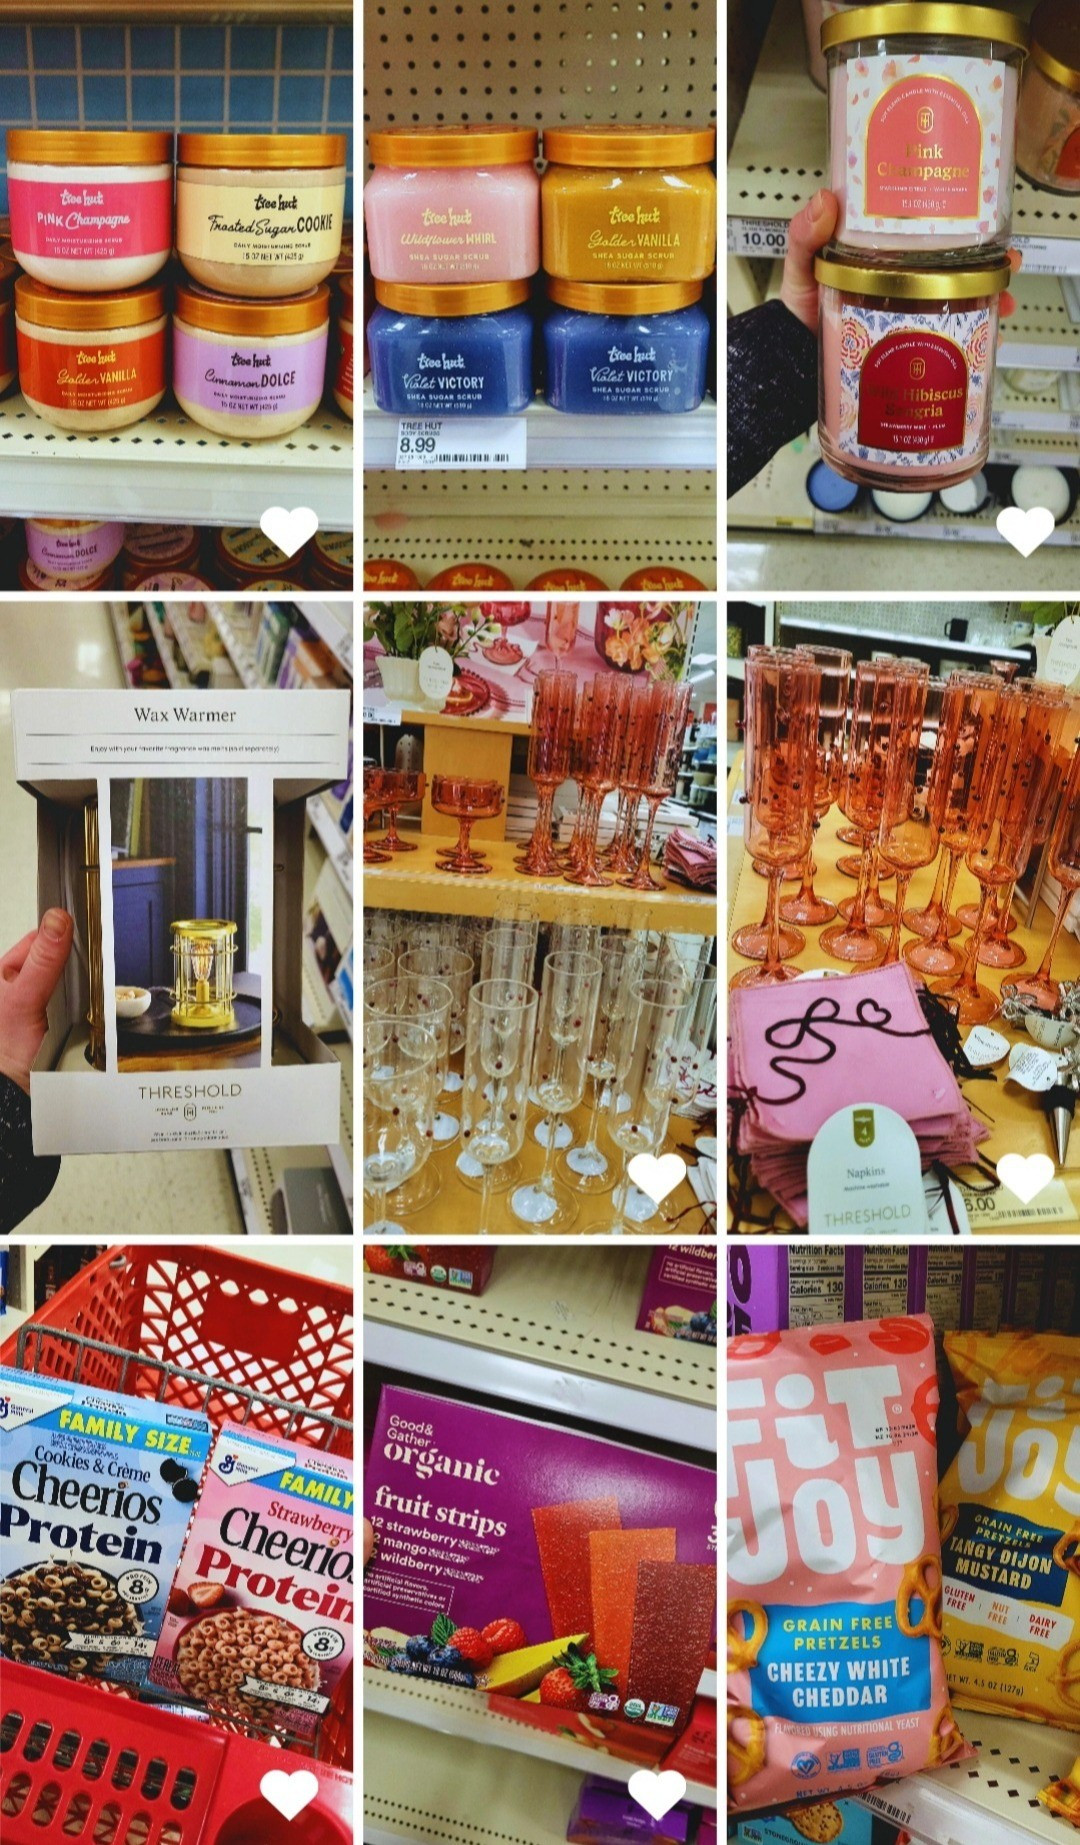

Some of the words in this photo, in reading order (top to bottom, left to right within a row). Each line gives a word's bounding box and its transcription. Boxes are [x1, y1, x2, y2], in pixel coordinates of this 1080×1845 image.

[906, 144, 944, 159] Pink
[877, 162, 970, 181] Champagne
[60, 188, 82, 206] tree
[83, 189, 104, 206] hut
[254, 193, 277, 210] tree
[278, 193, 298, 210] hut
[37, 212, 64, 227] PINK
[66, 212, 130, 230] Champagne
[422, 208, 448, 226] tree
[448, 207, 472, 226] hut
[608, 205, 636, 224] tree
[635, 206, 660, 225] hut
[208, 214, 256, 233] Frosted
[254, 218, 297, 239] Sugar
[296, 213, 333, 233] COOKIE
[400, 232, 464, 247] Wildflower
[466, 232, 497, 245] WHIRL
[587, 229, 637, 249] Golden
[636, 232, 680, 247] VANILLA
[743, 232, 786, 246] 10.00
[408, 254, 430, 262] SHEA
[432, 254, 460, 262] SUGAR
[463, 254, 490, 262] SCRUB
[592, 252, 614, 260] SHEA
[616, 252, 644, 260] SUGAR
[648, 252, 675, 260] SCRUB
[76, 350, 97, 366] tree
[97, 350, 117, 365] hut
[230, 352, 252, 368] tree
[252, 352, 272, 368] hut
[417, 352, 442, 369] tree
[442, 352, 466, 370] hut
[608, 346, 632, 363] tree
[633, 346, 656, 363] hut
[56, 368, 100, 386] Golden
[100, 367, 137, 384] VANILLA
[204, 368, 260, 388] Cinnamon
[260, 370, 296, 388] DOLCE
[402, 374, 436, 390] Violet
[438, 376, 484, 389] VICTORY
[589, 366, 625, 382] Violet
[626, 368, 674, 382] VICTORY
[904, 386, 964, 403] Hibiscus
[885, 402, 944, 421] Sangria
[401, 422, 422, 430] TREE
[424, 422, 442, 430] HUT
[400, 437, 436, 453] 8.99
[75, 544, 98, 558] DOLCE
[134, 707, 170, 723] Wax
[173, 707, 238, 723] Warmer
[90, 745, 108, 754] Enjoy
[124, 746, 138, 754] your
[138, 1083, 242, 1100] THRESHOLD
[847, 1166, 886, 1180] Napkins
[965, 1197, 996, 1212] 6.00
[824, 1204, 912, 1228] THRESHOLD
[789, 1245, 822, 1254] Nutrition
[824, 1245, 844, 1256] Facts
[864, 1245, 892, 1254] Nutrition
[892, 1245, 908, 1255] Facts
[790, 1285, 822, 1294] Calories
[827, 1281, 844, 1293] 130
[864, 1282, 890, 1290] Calories
[894, 1278, 907, 1288] 130
[10, 1404, 34, 1414] General
[59, 1410, 140, 1444] FAMILY
[145, 1430, 192, 1456] SIZE
[390, 1415, 434, 1436] Good&
[387, 1428, 431, 1448] Gather
[34, 1446, 90, 1471] Cookies
[93, 1460, 105, 1474] &
[108, 1461, 150, 1484] Crème
[384, 1442, 500, 1486] organic
[12, 1461, 163, 1525] Cheerios
[279, 1472, 353, 1510] FAMILY
[374, 1485, 433, 1519] fruit
[434, 1504, 508, 1538] strips
[268, 1501, 353, 1544] Strawberry
[974, 1514, 1012, 1532] GRAIN
[1016, 1527, 1044, 1544] FREE
[0, 1503, 162, 1564] Protein
[371, 1516, 384, 1529] 12
[386, 1520, 458, 1548] strawberry
[976, 1527, 1030, 1548] PRETZELS
[383, 1537, 428, 1558] mango
[950, 1536, 996, 1562] TANGY
[1000, 1548, 1052, 1575] DIJON
[380, 1552, 444, 1576] wildberry
[126, 1574, 152, 1585] PROTEIN
[956, 1557, 1032, 1590] MUSTARD
[129, 1580, 144, 1594] 8
[374, 1574, 404, 1585] artificial
[404, 1580, 429, 1592] flavors,
[392, 1585, 438, 1600] preservatives
[392, 1592, 423, 1604] synthetic
[424, 1600, 446, 1609] colors
[944, 1585, 976, 1602] GLUTEN
[946, 1598, 967, 1612] FREE
[992, 1601, 1010, 1614] NUT
[782, 1618, 842, 1632] GRAIN
[852, 1616, 892, 1630] FREE
[988, 1611, 1008, 1626] FREE
[1029, 1614, 1057, 1630] DAIRY
[313, 1631, 339, 1644] PROTEIN
[1030, 1626, 1050, 1640] FREE
[314, 1638, 330, 1652] 8
[794, 1636, 882, 1650] PRETZELS
[767, 1662, 840, 1682] CHEEZY
[847, 1656, 910, 1680] WHITE
[960, 1675, 971, 1686] WT.
[974, 1678, 985, 1688] 4.5
[988, 1680, 998, 1690] OZ
[1000, 1684, 1024, 1698] (127g)
[792, 1685, 888, 1708] CHEDDAR
[774, 1724, 812, 1736] FLAVORED
[813, 1725, 838, 1738] USING
[840, 1721, 894, 1736] NUTRITIONAL
[896, 1717, 920, 1730] YEAST
